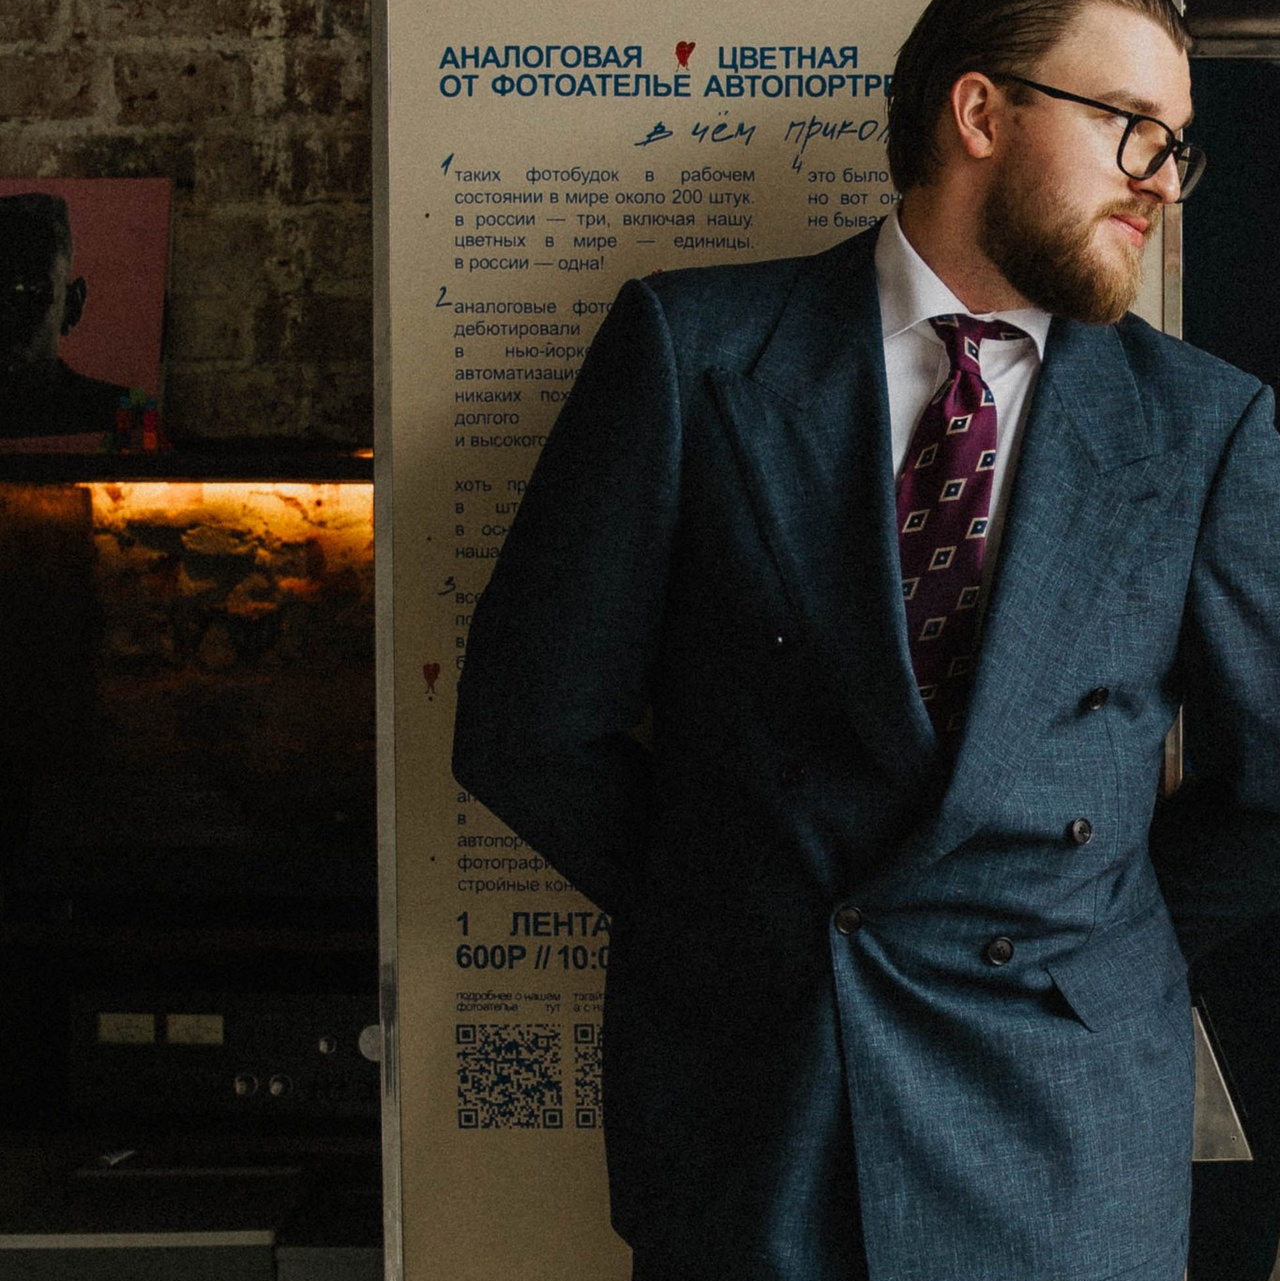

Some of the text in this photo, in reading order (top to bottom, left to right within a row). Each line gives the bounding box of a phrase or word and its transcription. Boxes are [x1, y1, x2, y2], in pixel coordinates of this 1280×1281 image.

[439, 45, 858, 73] АНАЛОГОВАЯ ЦВЕТНАЯ
[439, 73, 479, 97] ОТ
[491, 73, 692, 98] ФОТОАТЕЛЬЕ
[454, 167, 755, 185] таких фотобудок в рабочем
[808, 168, 888, 182] это было
[454, 189, 755, 207] состоянии в мире около 200 штук.
[808, 194, 829, 205] но
[840, 194, 868, 205] вот
[455, 215, 464, 226] в
[476, 214, 536, 229] россии
[576, 214, 611, 229] три,
[623, 214, 695, 226] включая
[808, 212, 880, 227] не быва
[454, 236, 526, 249] цветных
[545, 236, 554, 248] в
[573, 236, 617, 251] мире
[674, 236, 754, 250] единицы.
[455, 258, 464, 269] в
[469, 258, 529, 272] россии
[558, 256, 605, 271] одна!
[436, 286, 452, 307] 2
[454, 299, 611, 317] аналоговые фото
[453, 320, 580, 338] дебютировали
[455, 347, 464, 358] в
[455, 391, 521, 402] никаких
[454, 413, 519, 428] долгого
[455, 435, 550, 447] и высокого
[455, 480, 492, 492] хоть
[456, 503, 464, 513] в
[456, 525, 464, 536] в
[456, 547, 500, 558] наша
[458, 814, 466, 825] в
[458, 835, 530, 849] автопор
[458, 877, 540, 894] стройные
[457, 911, 610, 937] 1 ЛЕНТА
[455, 944, 526, 969] 600Р
[457, 990, 561, 1003] подробнее о нашем
[457, 1002, 561, 1014] фотоателье тут
